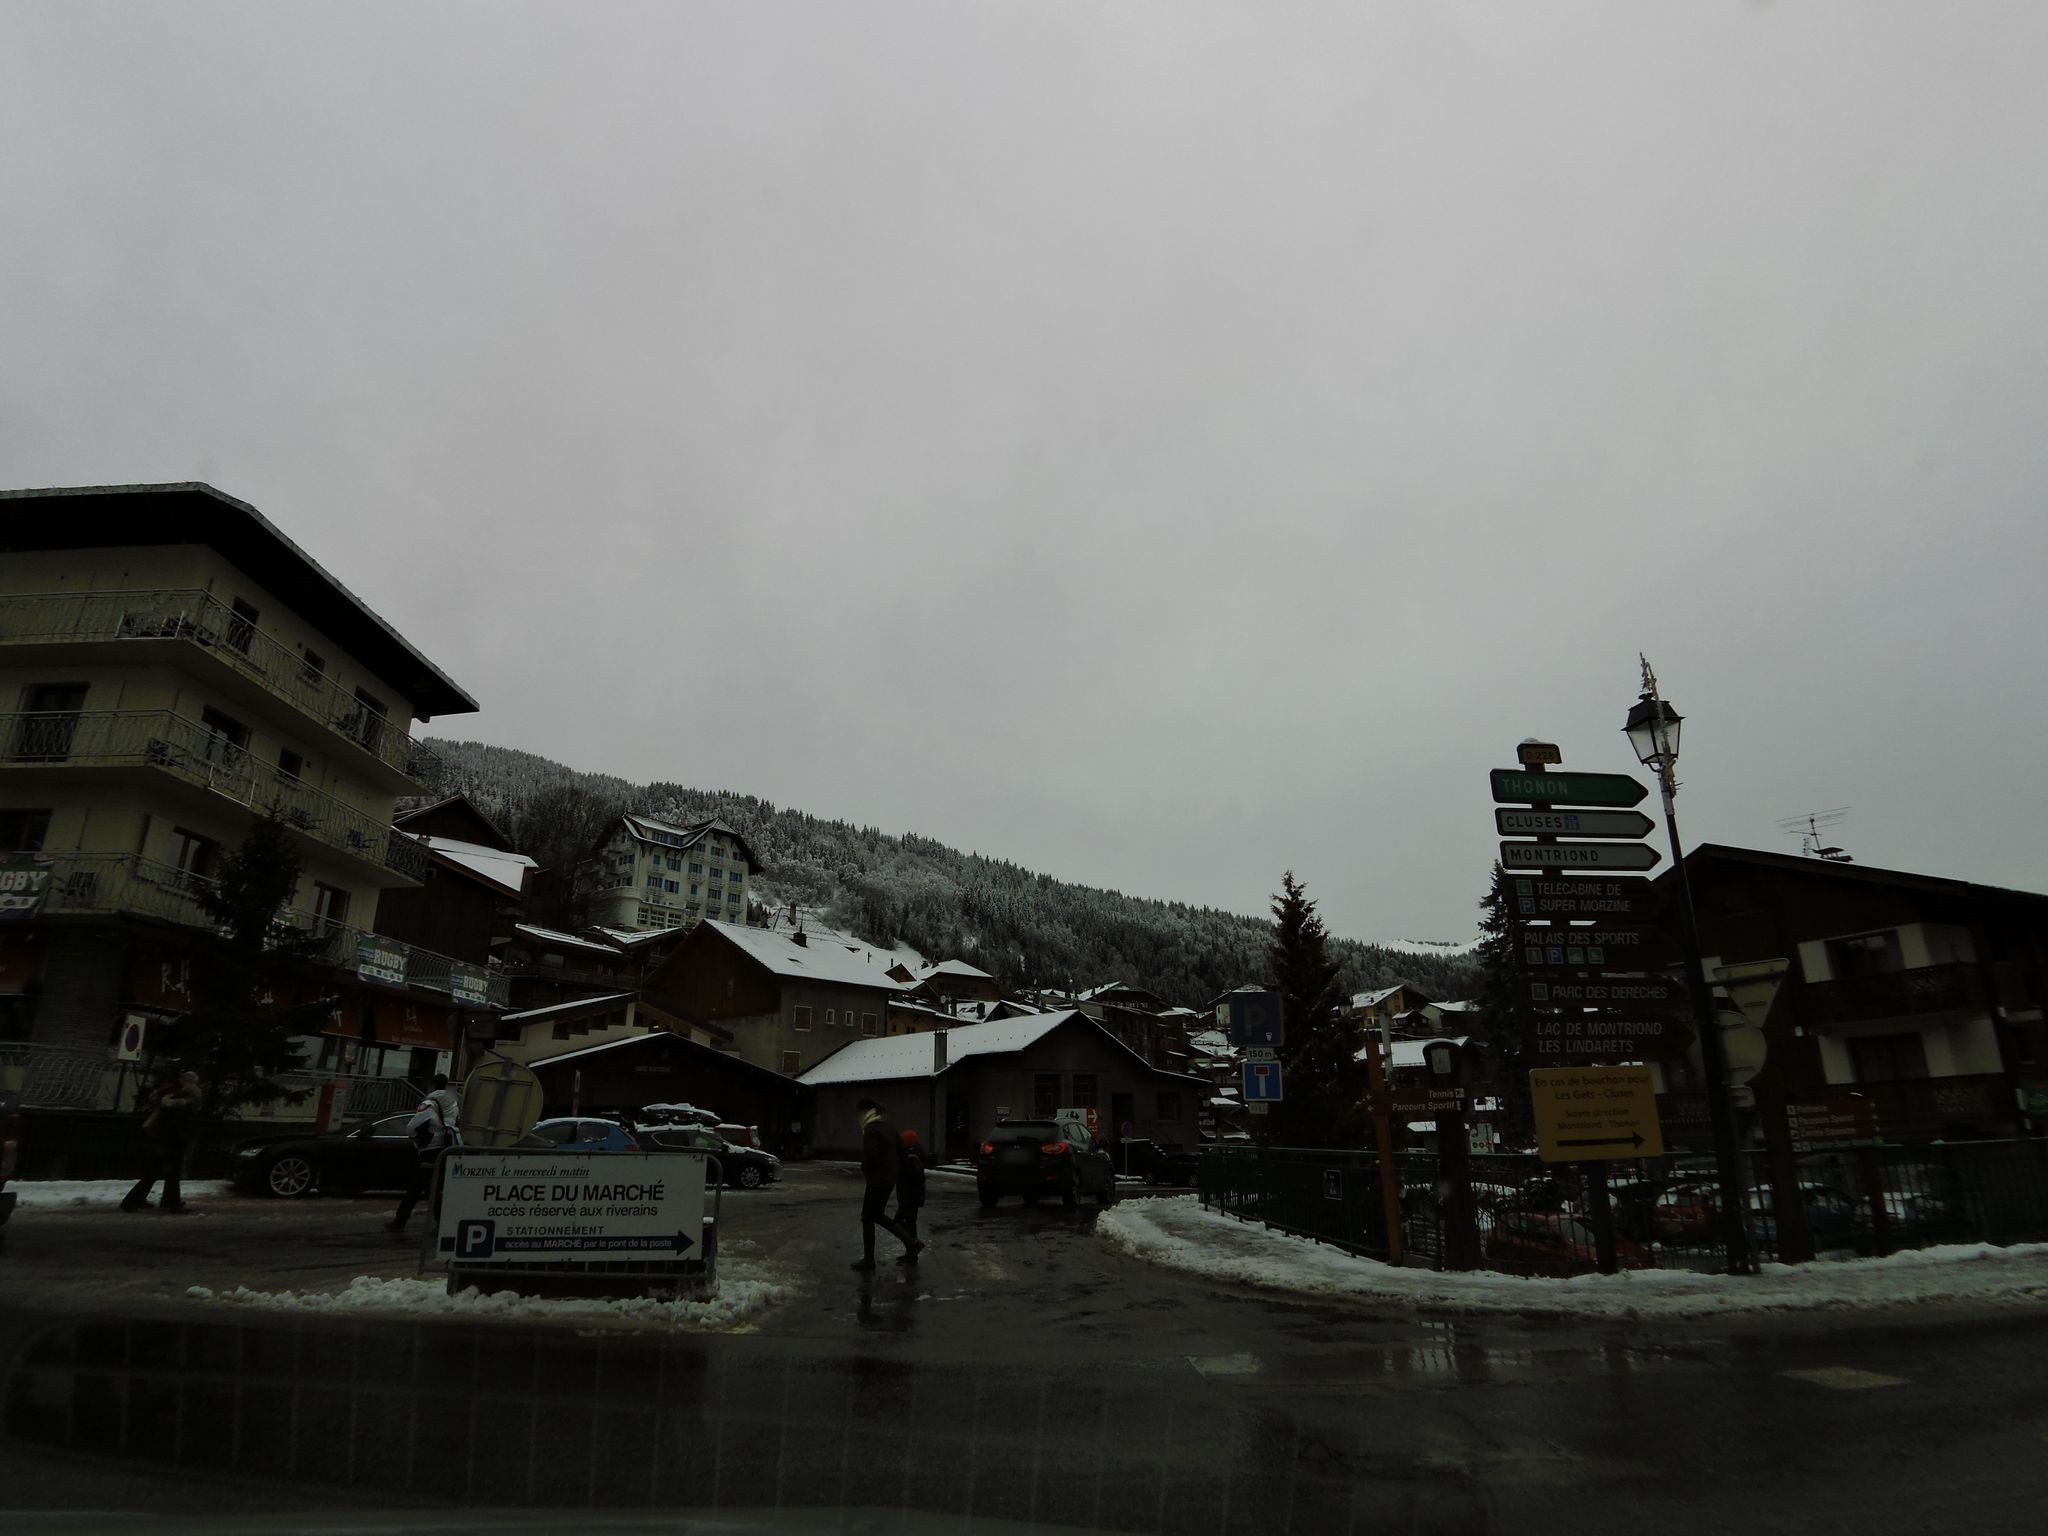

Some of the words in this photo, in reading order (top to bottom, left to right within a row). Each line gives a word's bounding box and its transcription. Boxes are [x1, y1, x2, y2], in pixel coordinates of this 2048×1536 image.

[1502, 778, 1569, 796] THONON
[1506, 815, 1562, 829] CLUSES
[1510, 849, 1600, 862] MONTRIOND
[0, 871, 48, 891] GBY
[1606, 884, 1621, 896] DE
[1540, 900, 1577, 912] SUPER
[1579, 900, 1632, 912] MORZINE
[1524, 932, 1564, 945] PALAIS
[1568, 933, 1592, 945] DES
[1594, 932, 1640, 945] SPORTS
[374, 949, 407, 970] RUGBY
[463, 975, 488, 992] RUGBY
[1552, 986, 1582, 998] PARC
[1586, 986, 1607, 998] DES
[1611, 986, 1668, 998] DERECHES
[1537, 1022, 1561, 1035] LAC
[1566, 1022, 1583, 1035] DE
[1587, 1022, 1663, 1035] MONTRIOND
[1539, 1040, 1560, 1053] LES
[1566, 1040, 1634, 1053] LINDARETS
[1535, 1078, 1548, 1087] En
[1550, 1078, 1566, 1087] cas
[1568, 1076, 1580, 1086] de
[1582, 1075, 1625, 1085] bouchon
[1627, 1076, 1648, 1086] pour
[1428, 1090, 1454, 1098] Tennis
[1555, 1092, 1569, 1100] Les
[1573, 1090, 1595, 1099] Gets
[1392, 1103, 1426, 1111] Parcours
[1428, 1101, 1455, 1111] Sportif
[1592, 1108, 1630, 1117] direction
[1557, 1120, 1602, 1130] Montriond
[452, 1162, 496, 1177] MORZINE
[500, 1164, 510, 1177] le
[512, 1164, 557, 1177] mercredi
[560, 1165, 590, 1177] matin
[484, 1185, 546, 1201] PLACE
[552, 1185, 579, 1201] DU
[583, 1180, 665, 1201] MARCHÉ
[488, 1204, 525, 1217] accès
[529, 1204, 577, 1216] réservé
[580, 1206, 602, 1216] aux
[606, 1204, 658, 1216] riverains
[506, 1226, 604, 1236] STATIONNEMENT
[544, 1237, 583, 1248] MARCHÉ
[584, 1241, 598, 1251] par
[599, 1240, 608, 1248] le
[610, 1240, 626, 1251] pont
[628, 1239, 639, 1248] de
[640, 1239, 648, 1248] la
[649, 1240, 672, 1251] poste
